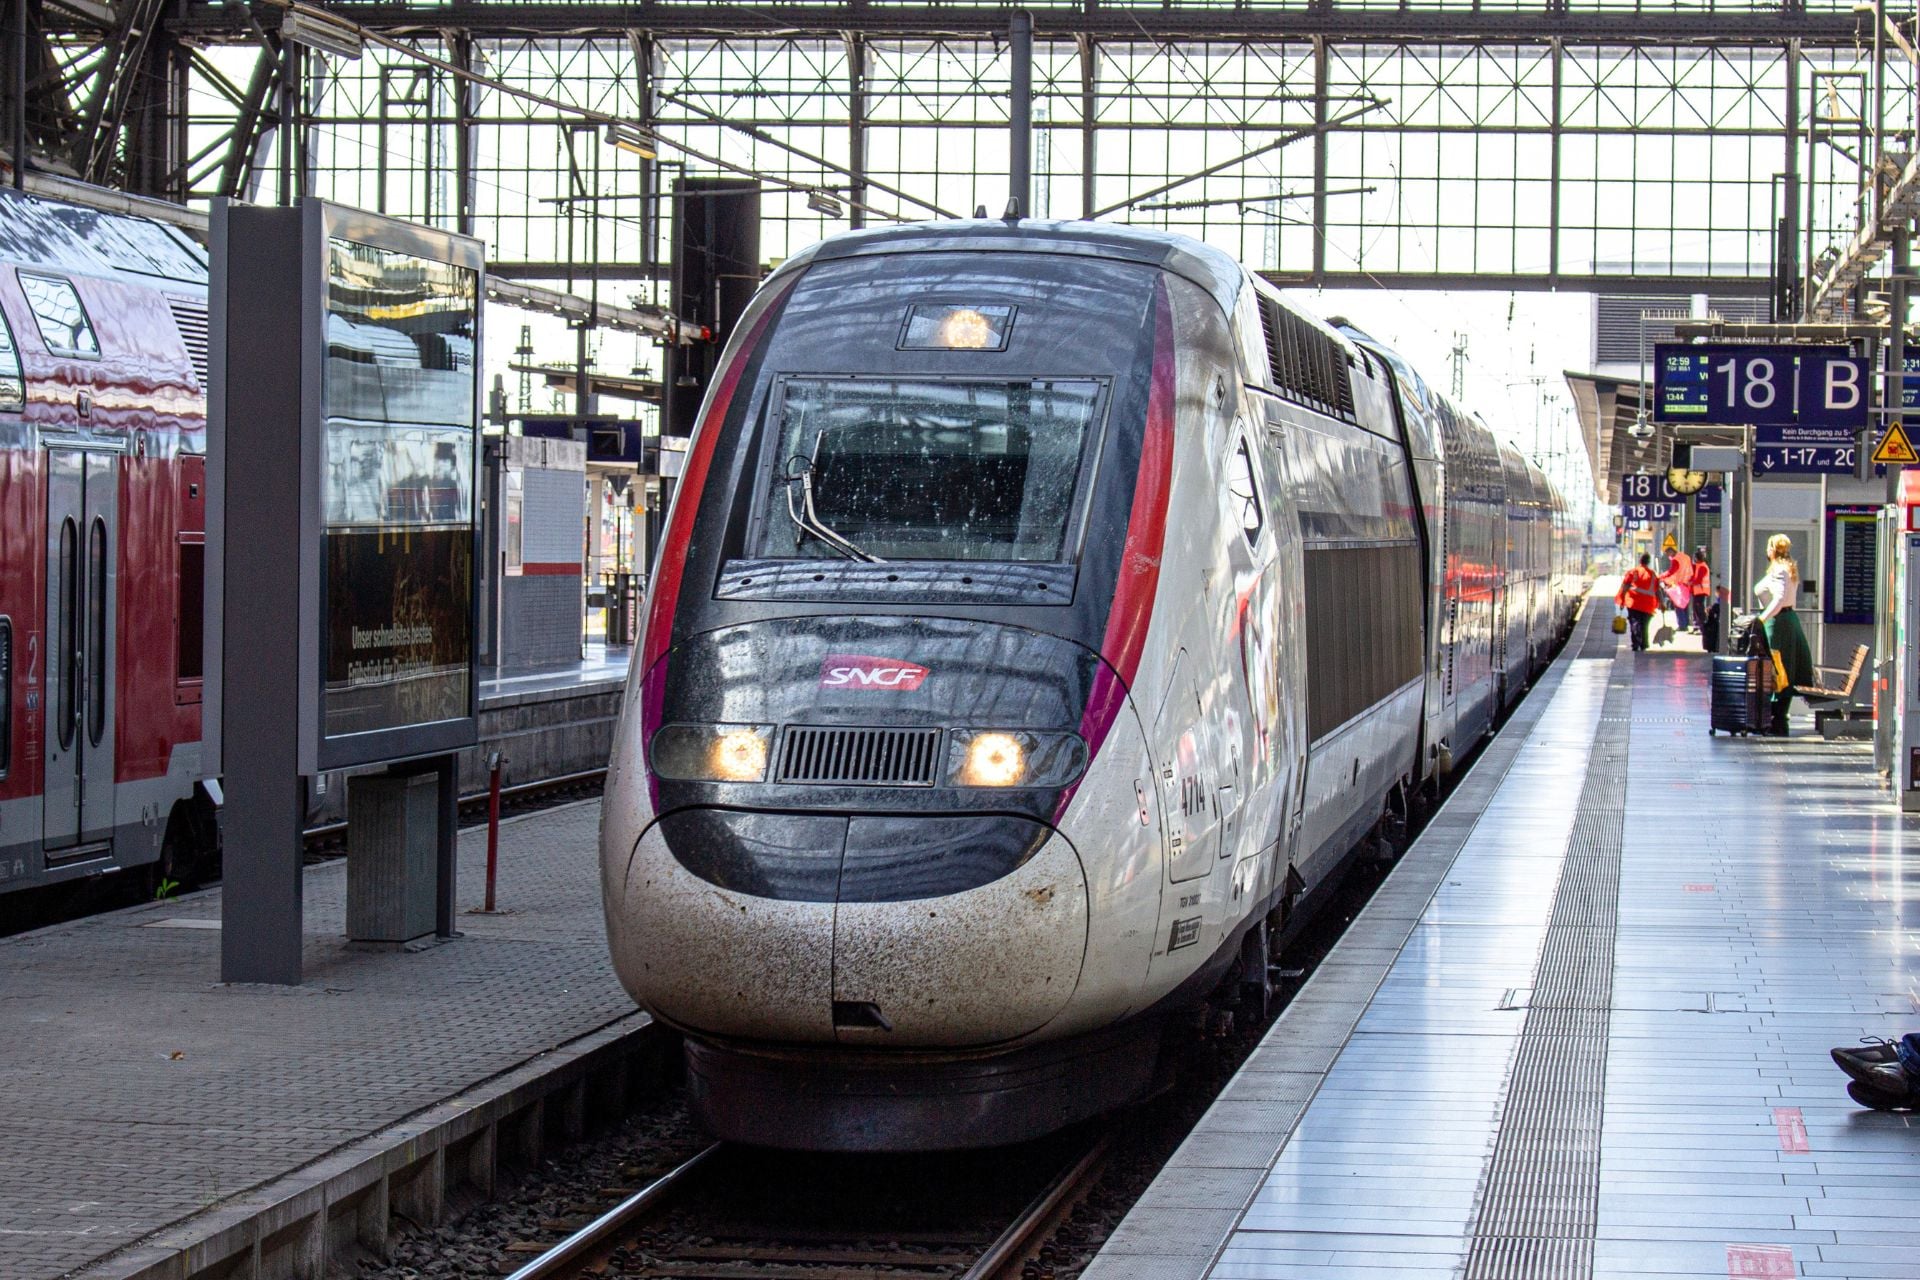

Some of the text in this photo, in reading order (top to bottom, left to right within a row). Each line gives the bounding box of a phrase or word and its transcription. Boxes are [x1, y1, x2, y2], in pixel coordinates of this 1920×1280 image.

[1716, 358, 1776, 408] 18
[1824, 360, 1861, 410] B
[1782, 428, 1797, 436] Kein
[1798, 428, 1833, 438] Durchgang
[1781, 447, 1855, 467] 1-17 und 20
[1625, 475, 1650, 497] 18
[1629, 504, 1665, 518] 18 D
[351, 621, 433, 650] Unser schnellstes bestes
[28, 635, 38, 684] 2
[347, 655, 434, 686] Frühstück für Deutschland
[823, 667, 922, 685] SNCF
[1181, 772, 1206, 817] 4714
